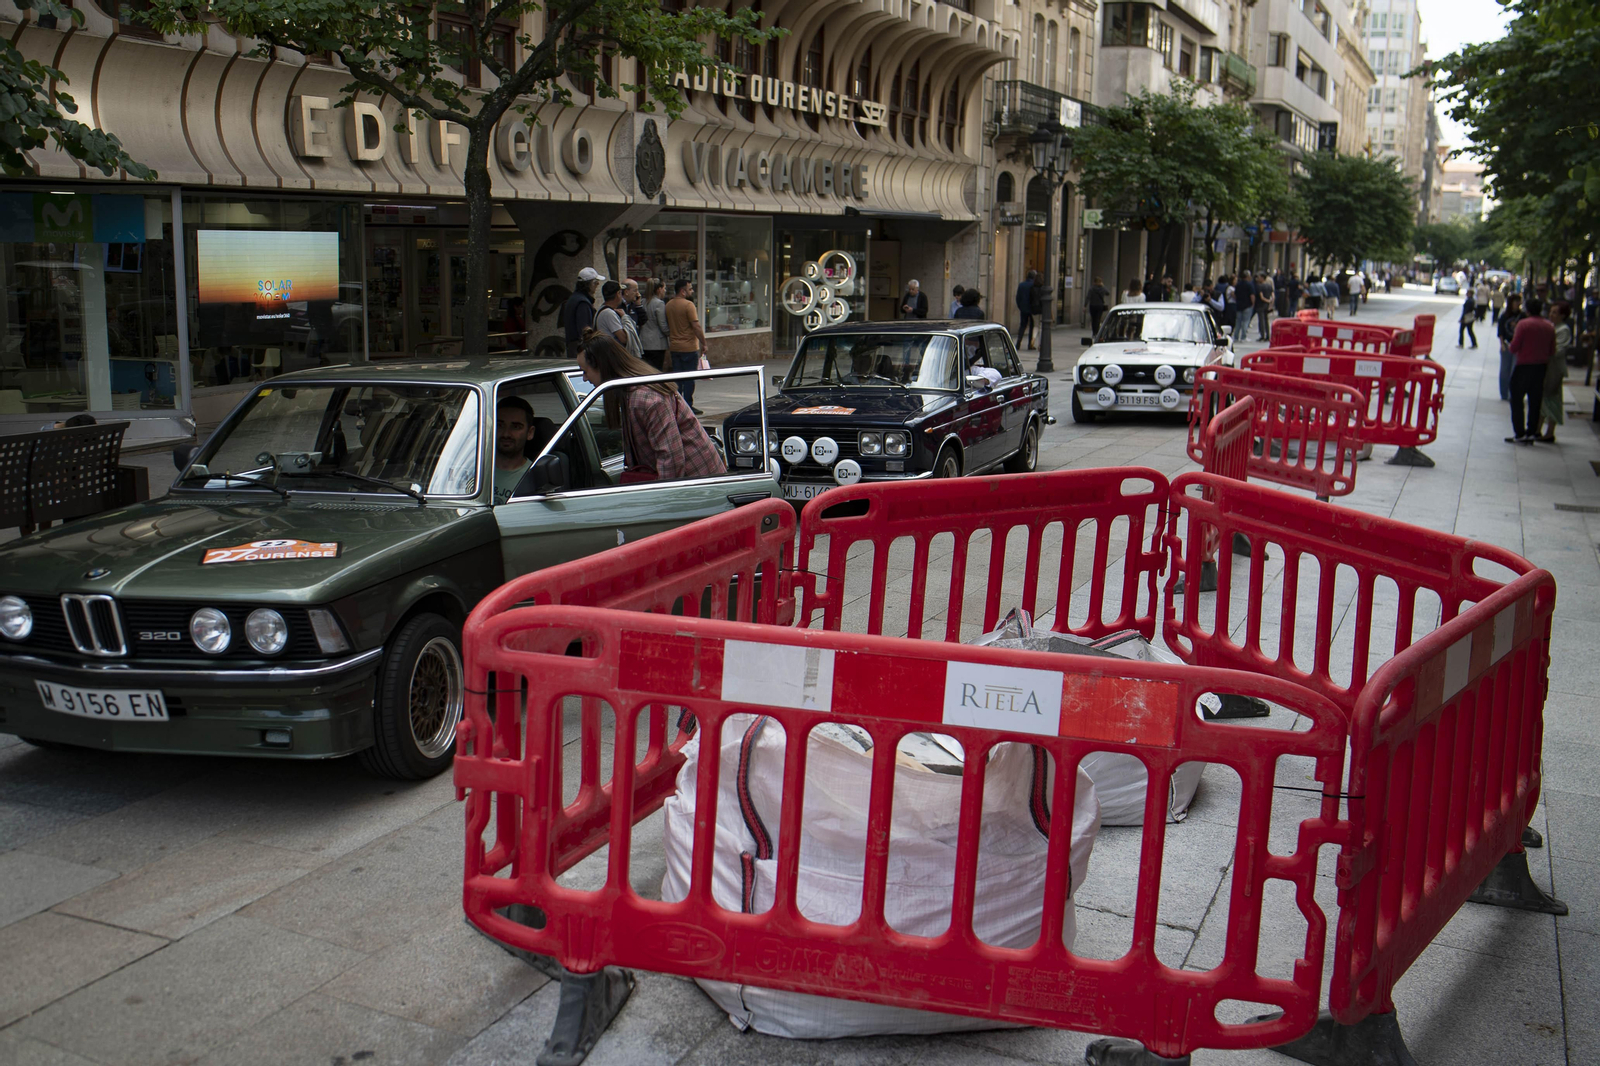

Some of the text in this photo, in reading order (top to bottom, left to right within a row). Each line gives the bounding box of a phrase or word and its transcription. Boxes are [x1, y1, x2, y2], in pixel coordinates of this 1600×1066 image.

[751, 74, 849, 119] OURENSE
[860, 100, 888, 127] SER
[293, 95, 868, 198] EDIFCIO VIACAMBRE
[43, 230, 84, 239] movistar
[258, 280, 292, 291] SOLAR
[1119, 396, 1142, 405] 5119
[203, 549, 334, 564] 27 OURENSE
[139, 631, 181, 640] 320
[40, 684, 164, 717] M 9156 EN
[960, 682, 1043, 715] RIELA
